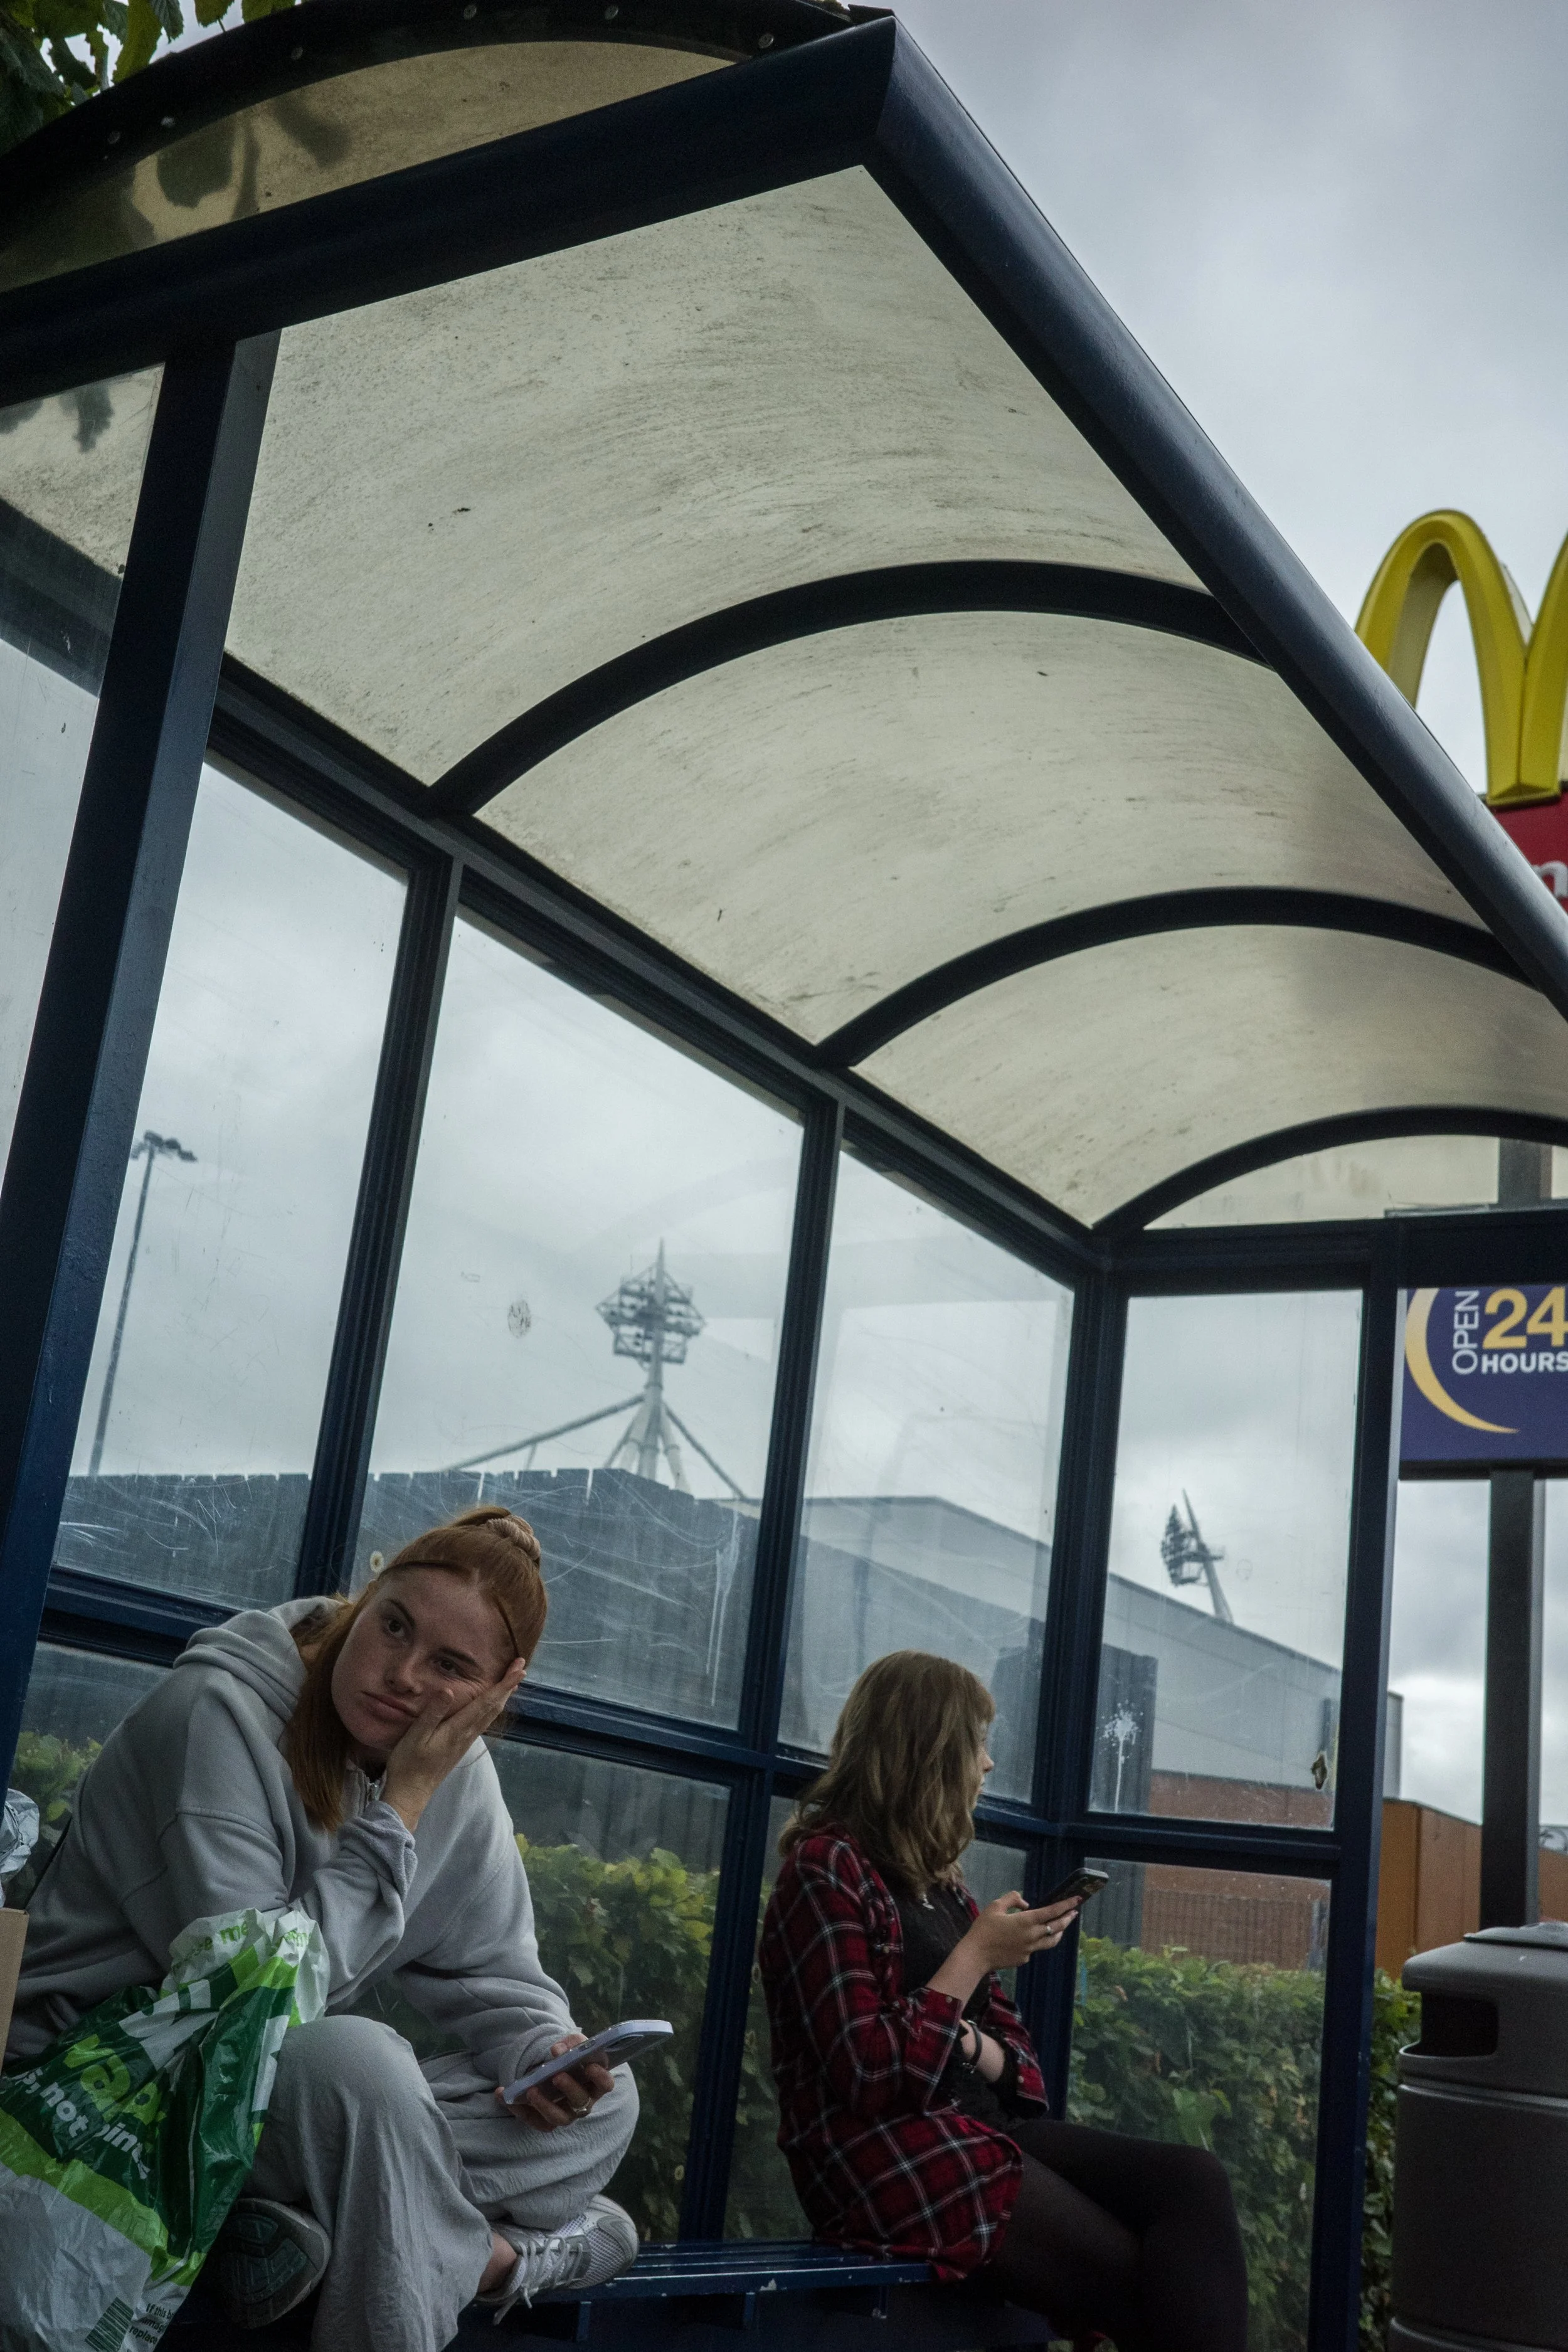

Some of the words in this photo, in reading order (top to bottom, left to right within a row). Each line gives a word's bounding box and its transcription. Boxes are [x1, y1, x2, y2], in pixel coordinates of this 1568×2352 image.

[1453, 1290, 1479, 1375] OPEN
[1482, 1286, 1568, 1350] 24
[1481, 1351, 1568, 1375] HOURS
[40, 2082, 90, 2138] not
[129, 2326, 158, 2344] replace
